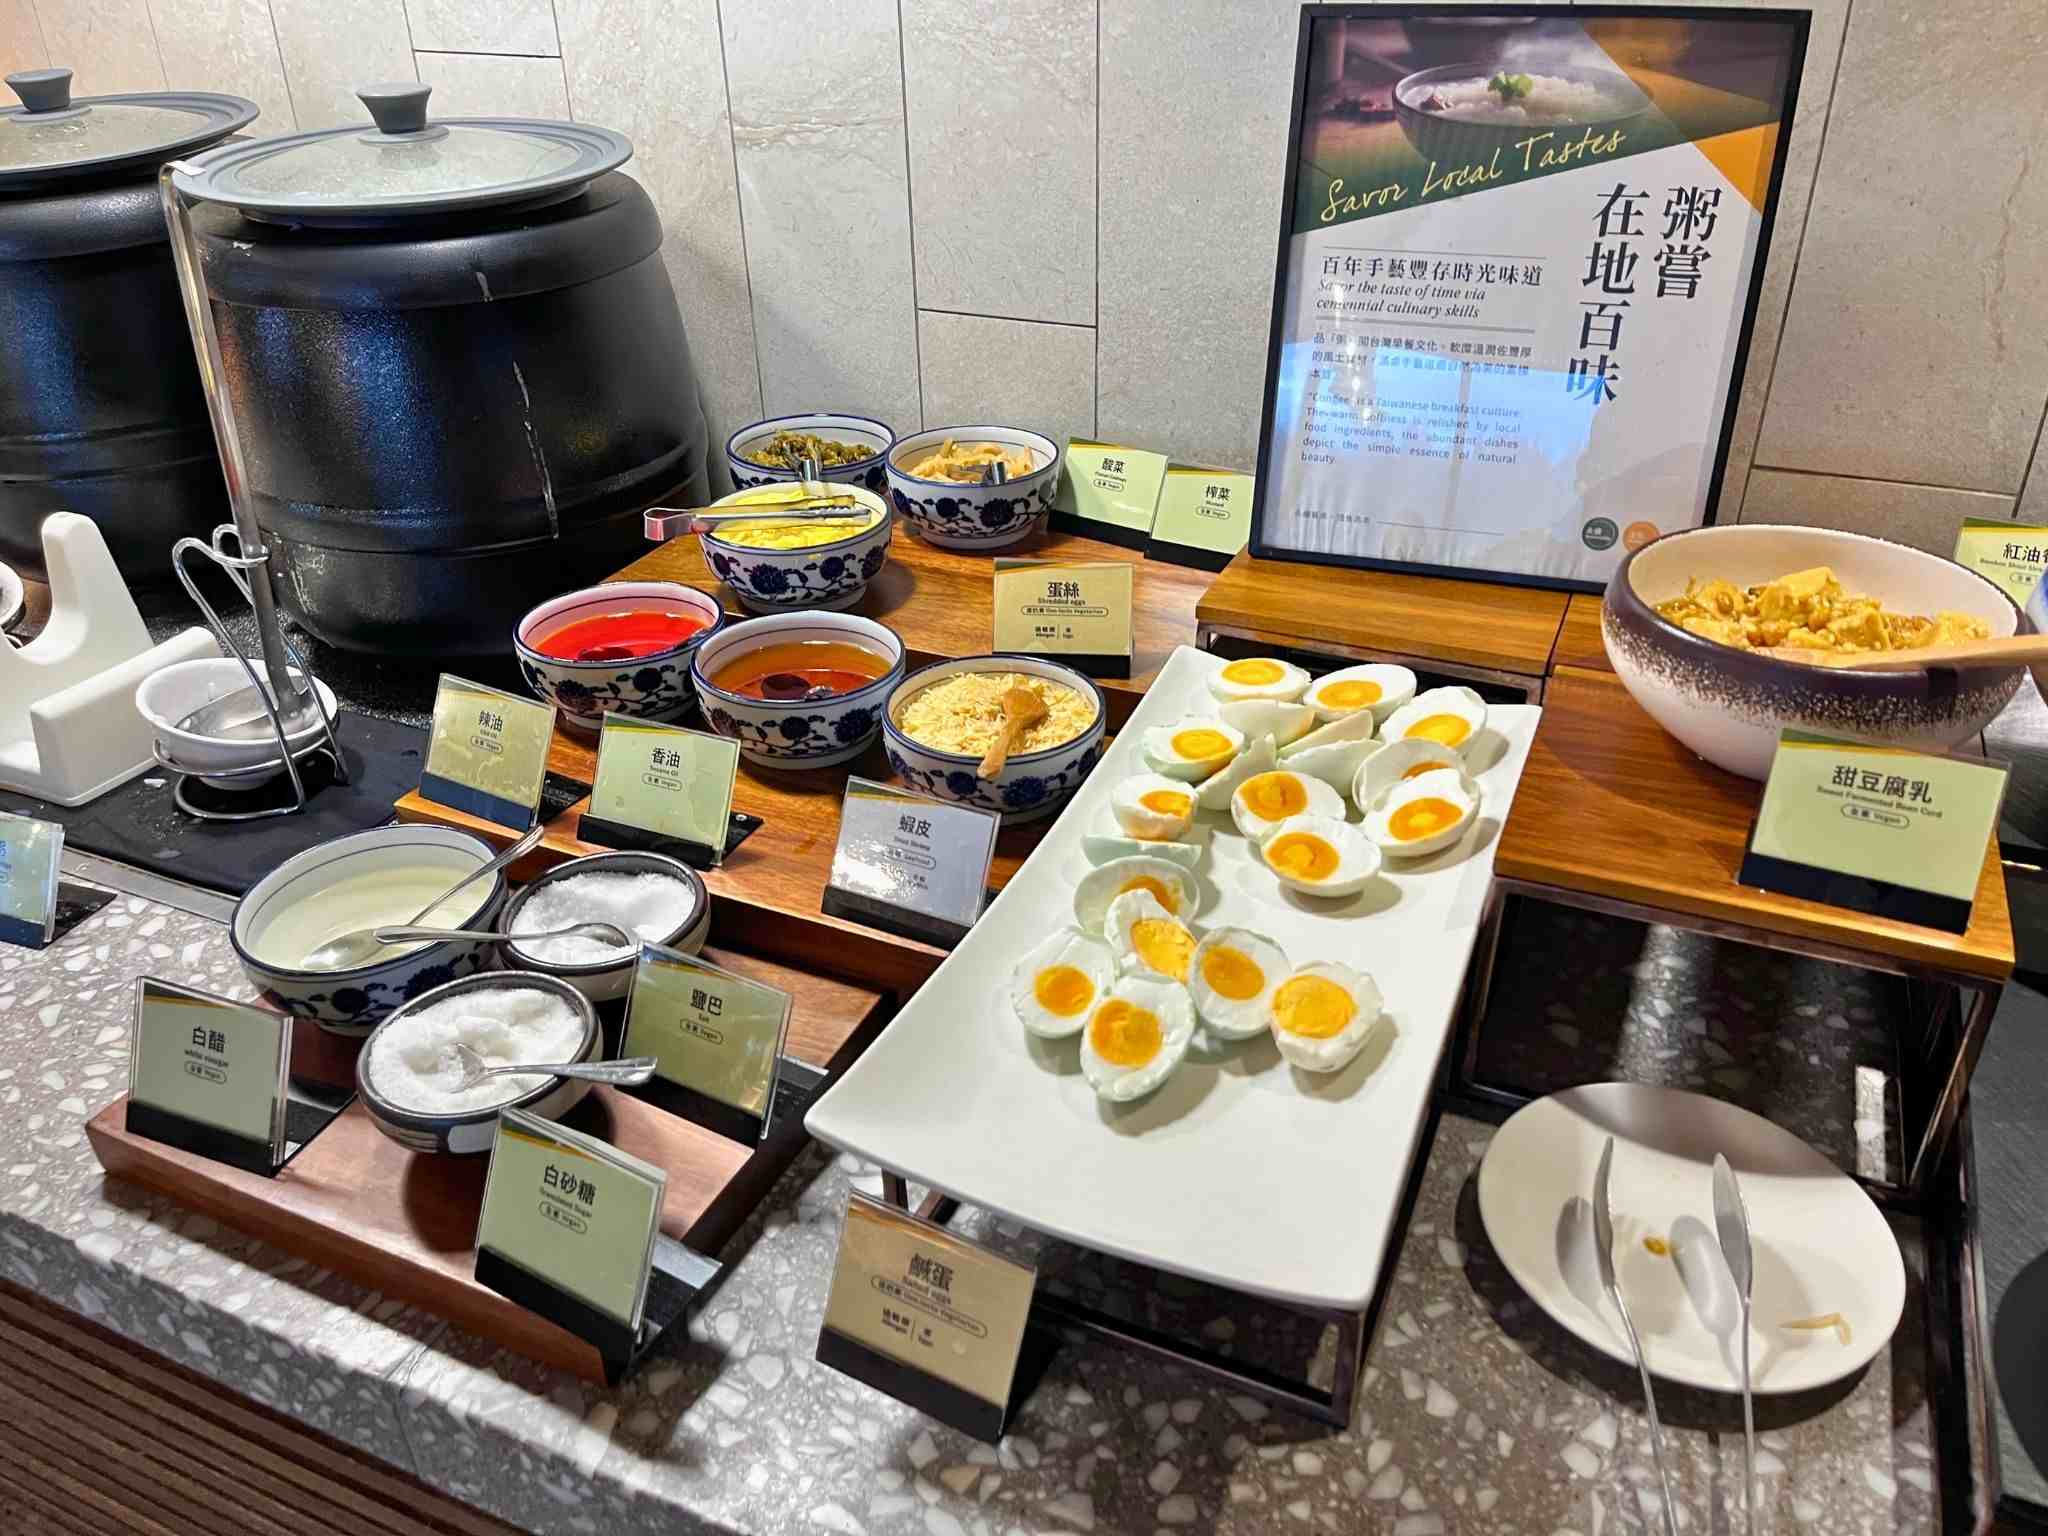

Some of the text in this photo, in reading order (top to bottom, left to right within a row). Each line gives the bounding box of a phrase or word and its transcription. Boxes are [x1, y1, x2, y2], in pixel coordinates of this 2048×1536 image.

[1320, 125, 1627, 223] Savor Local Tastes
[1653, 184, 1723, 299] 粥嘗
[1319, 278, 1486, 301] Saor the taste of time via
[1565, 182, 1651, 407] 在地百味
[1387, 301, 1442, 320] culinary
[1445, 305, 1481, 319] skills
[1304, 422, 1328, 434] food
[1484, 437, 1520, 450] dishes
[1476, 420, 1489, 434] by
[1495, 422, 1521, 434] local
[1302, 437, 1517, 464] depict the simple essence of natural
[2002, 543, 2048, 564] 紅油
[1047, 580, 1080, 599] 蛋絲
[479, 709, 503, 732] 辣油
[650, 747, 681, 769] 香油
[1831, 764, 1933, 805] 甜豆腐乳
[897, 813, 933, 839] 蝦皮
[690, 987, 724, 1017] 鹽巴
[192, 1026, 226, 1054] 白醋
[543, 1164, 597, 1206] 白砂糖
